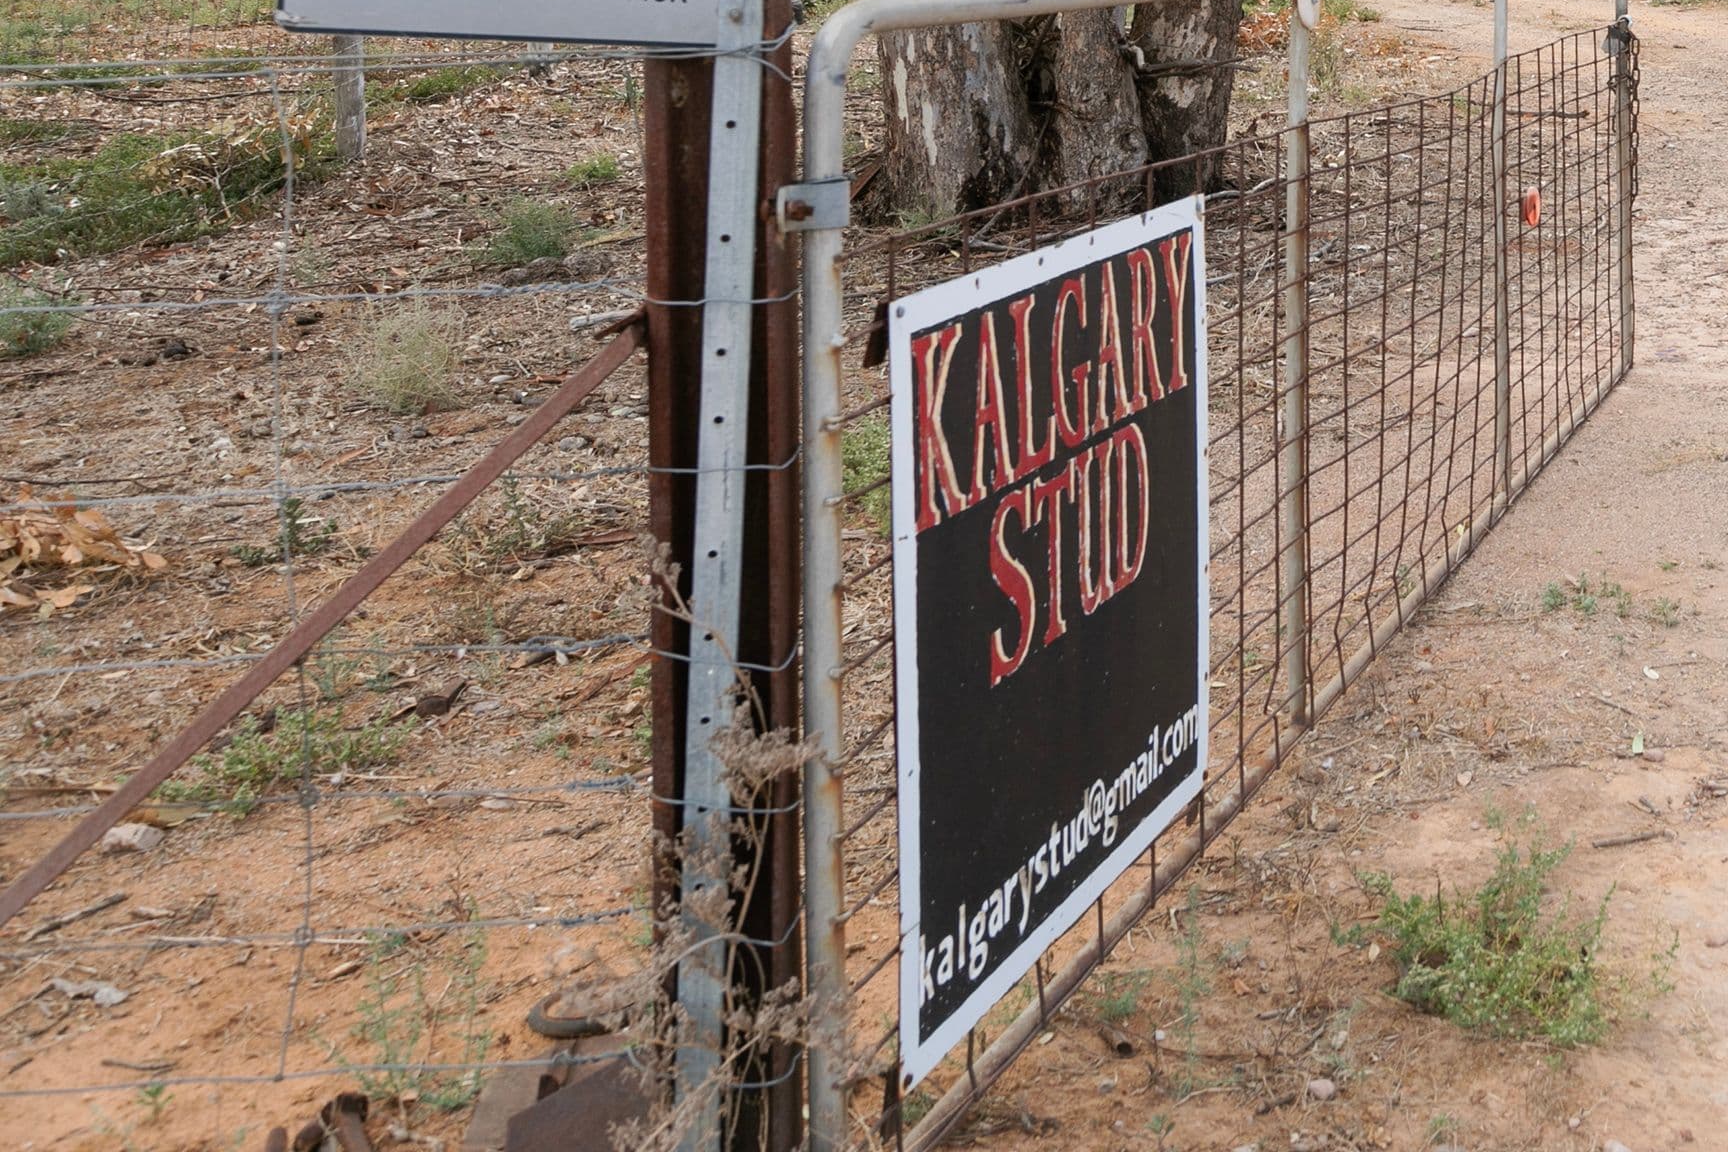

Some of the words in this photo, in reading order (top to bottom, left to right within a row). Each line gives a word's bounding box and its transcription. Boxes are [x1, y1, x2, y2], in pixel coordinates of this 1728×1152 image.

[911, 232, 1193, 533] KALGARY
[989, 422, 1149, 689] STUD
[919, 704, 1199, 1008] kalgarystud@gmail.com
